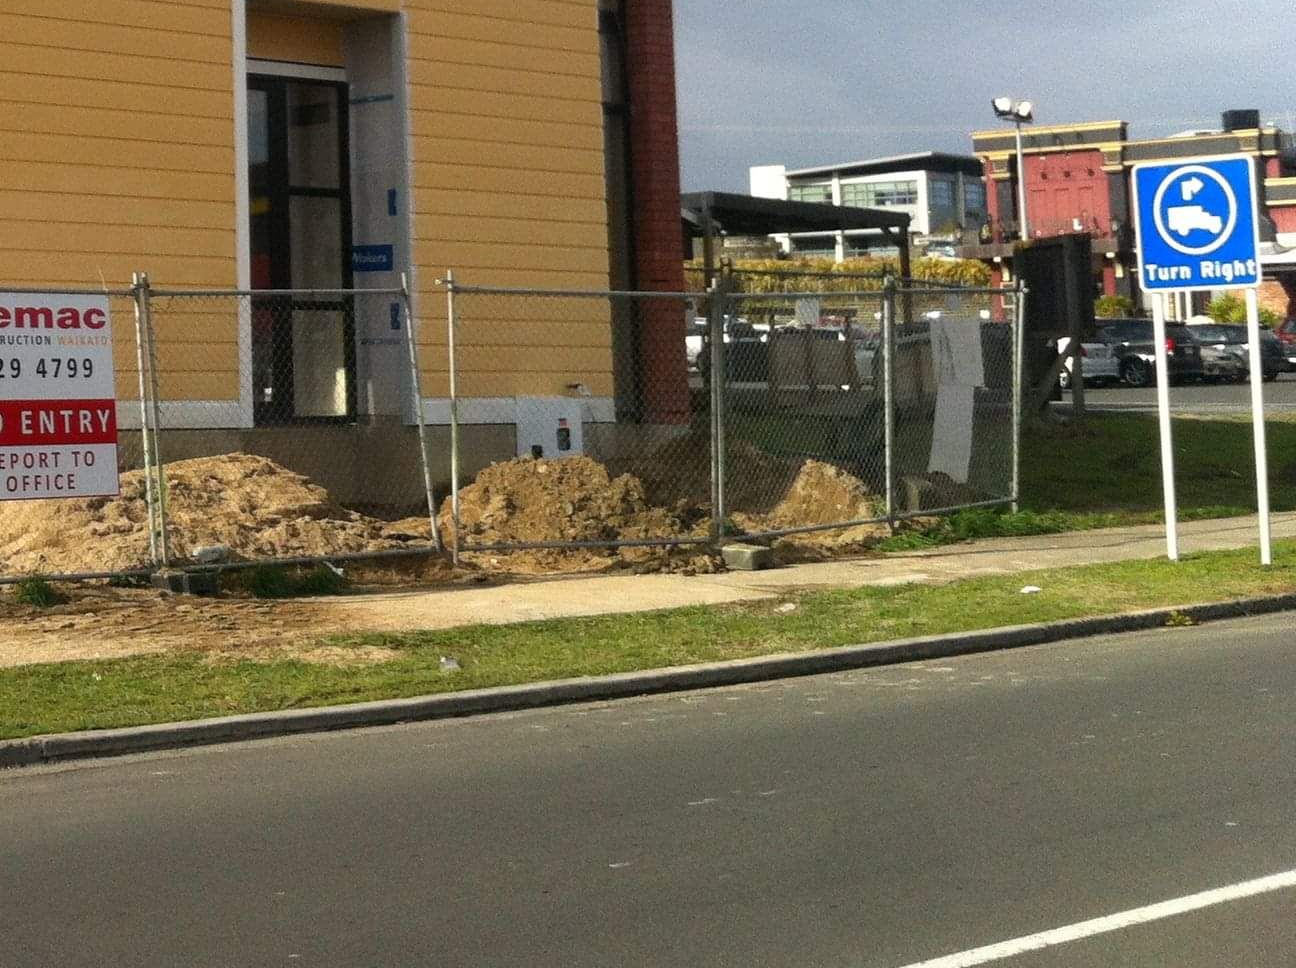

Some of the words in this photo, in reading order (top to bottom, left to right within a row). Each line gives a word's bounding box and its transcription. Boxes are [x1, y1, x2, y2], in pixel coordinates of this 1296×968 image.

[1145, 264, 1192, 281] Turn
[1200, 259, 1256, 281] Right
[36, 358, 93, 379] 4799
[21, 409, 110, 434] ENTRY
[72, 451, 95, 467] TO
[6, 474, 76, 492] OFFICE
